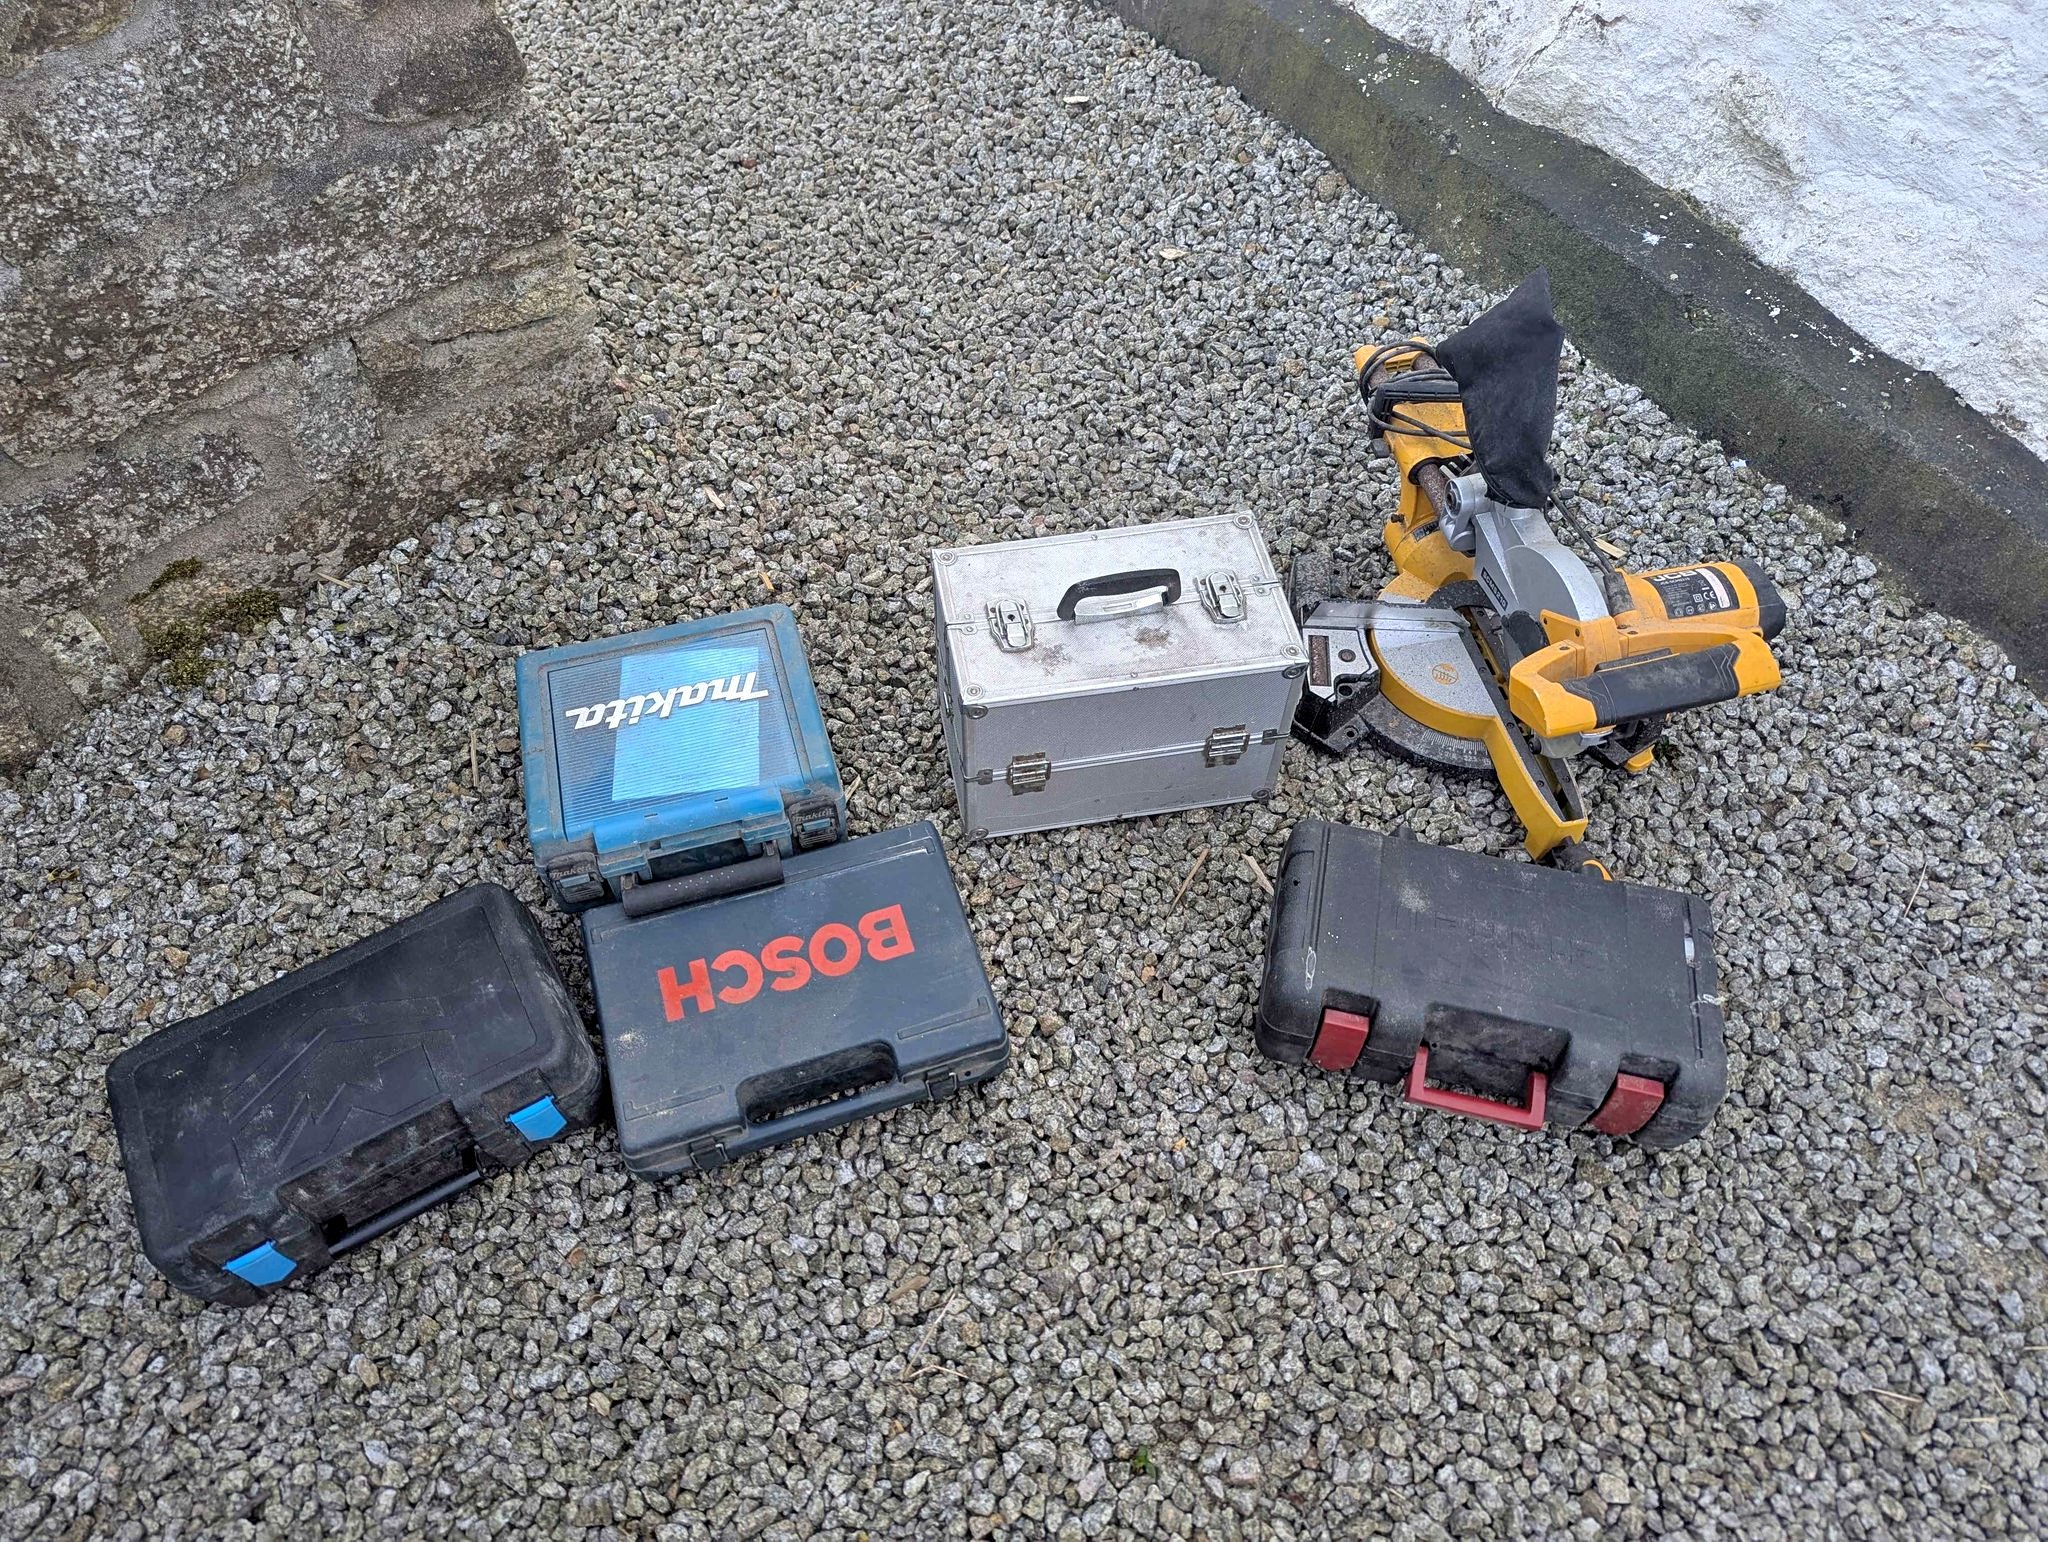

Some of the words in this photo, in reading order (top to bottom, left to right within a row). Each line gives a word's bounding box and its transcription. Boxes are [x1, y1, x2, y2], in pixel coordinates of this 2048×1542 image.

[1653, 570, 1698, 582] JCB
[565, 671, 769, 730] makita
[657, 903, 915, 1023] BOSCH
